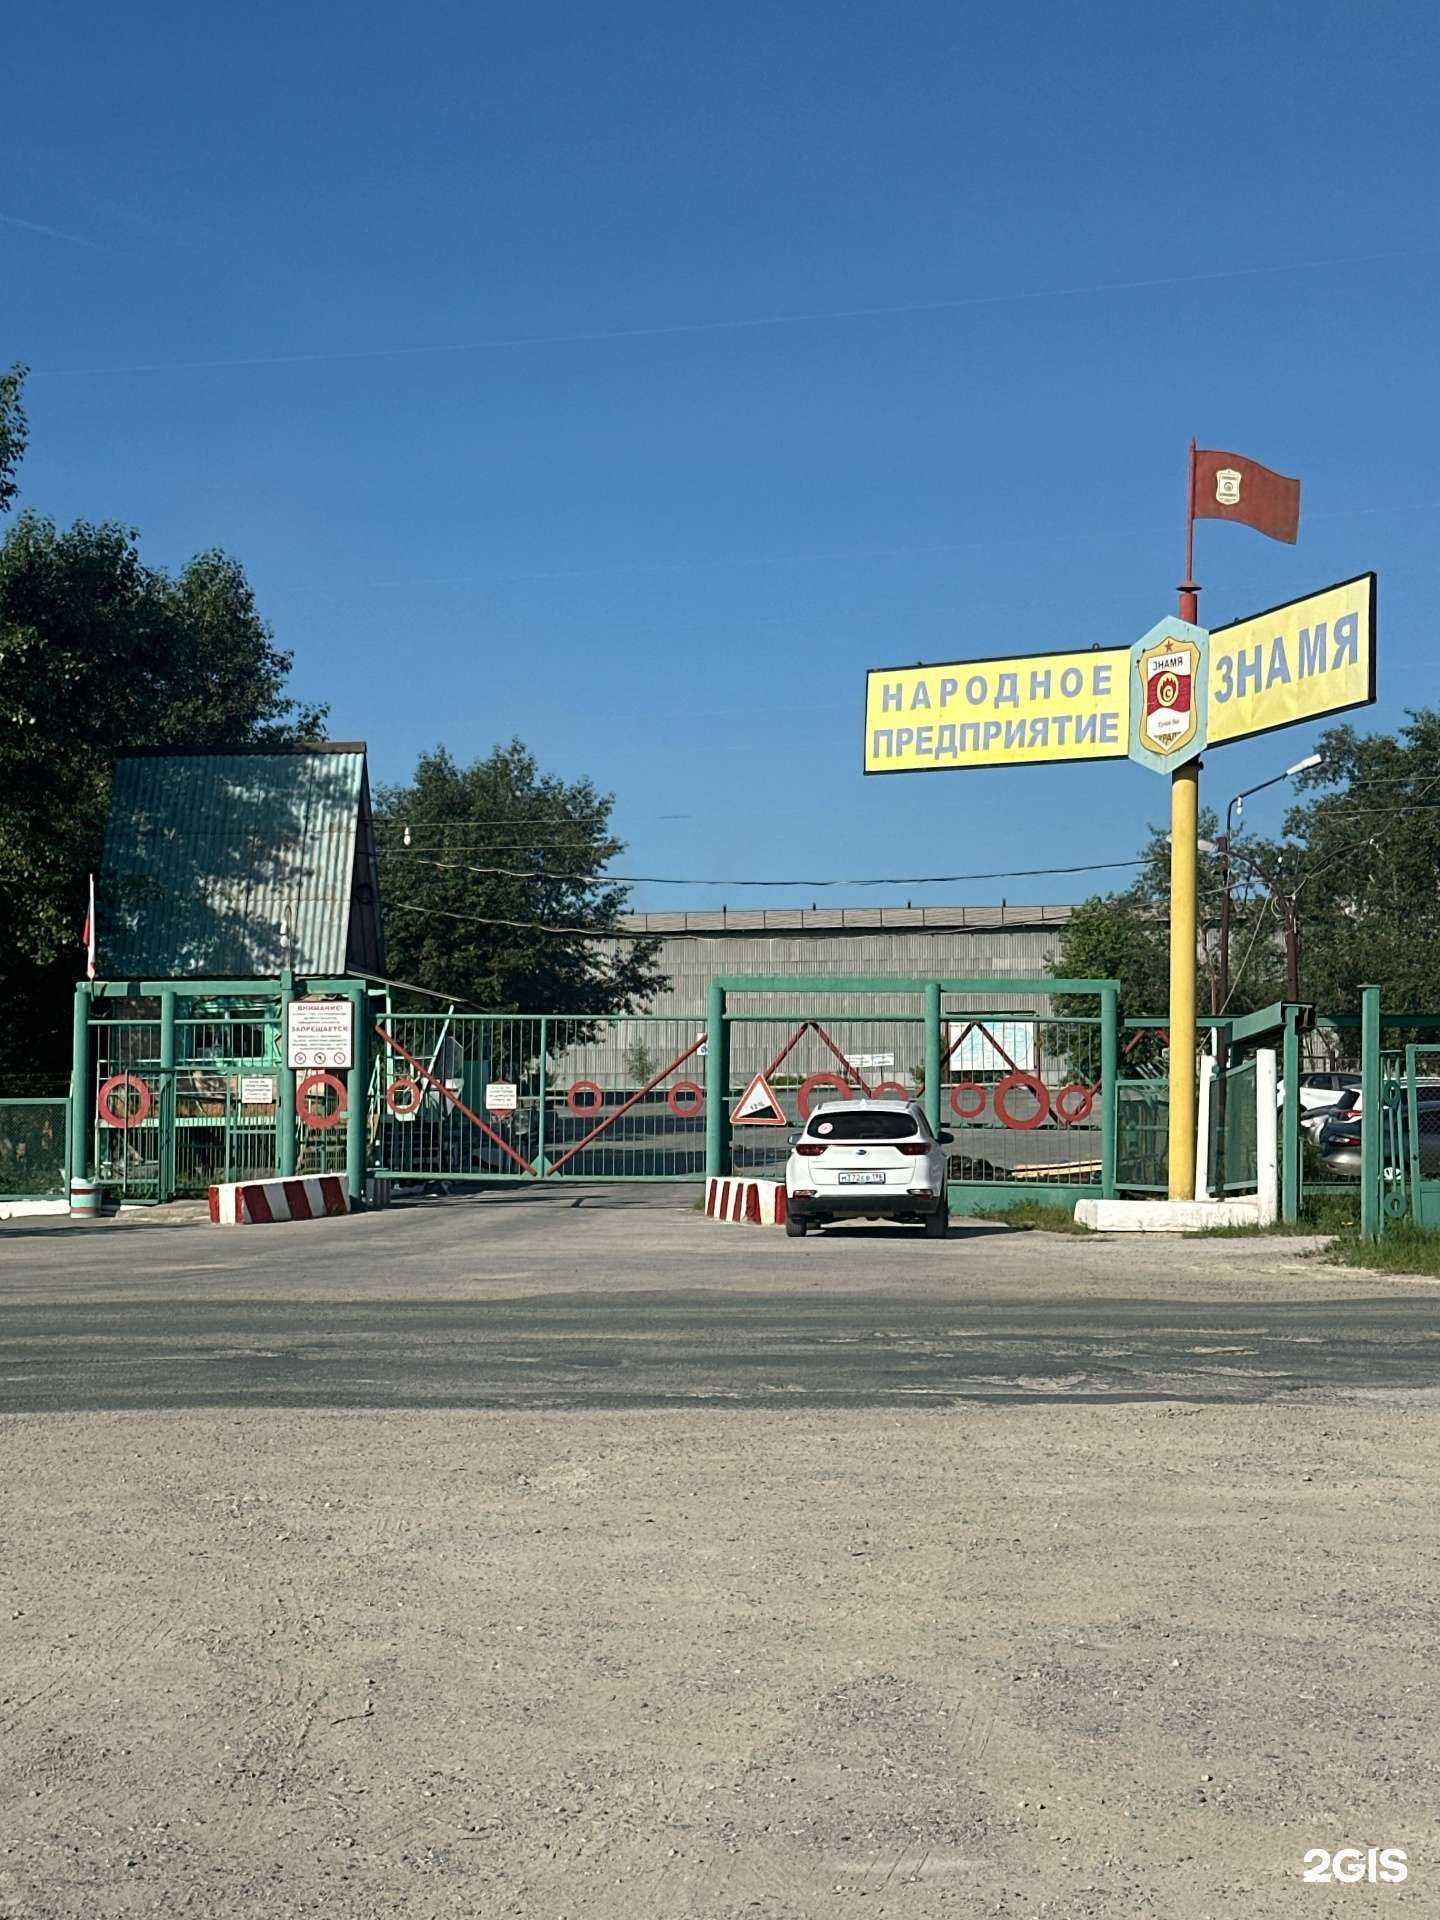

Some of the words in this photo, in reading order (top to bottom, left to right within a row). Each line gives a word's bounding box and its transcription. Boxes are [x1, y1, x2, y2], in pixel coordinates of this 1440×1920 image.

[1152, 656, 1183, 671] ЗНАМЯ
[1214, 612, 1359, 704] ЗНАМЯ
[882, 665, 1112, 713] НАРОДНОЕ
[873, 712, 1119, 760] ПРЕДПРИЯТИЕ
